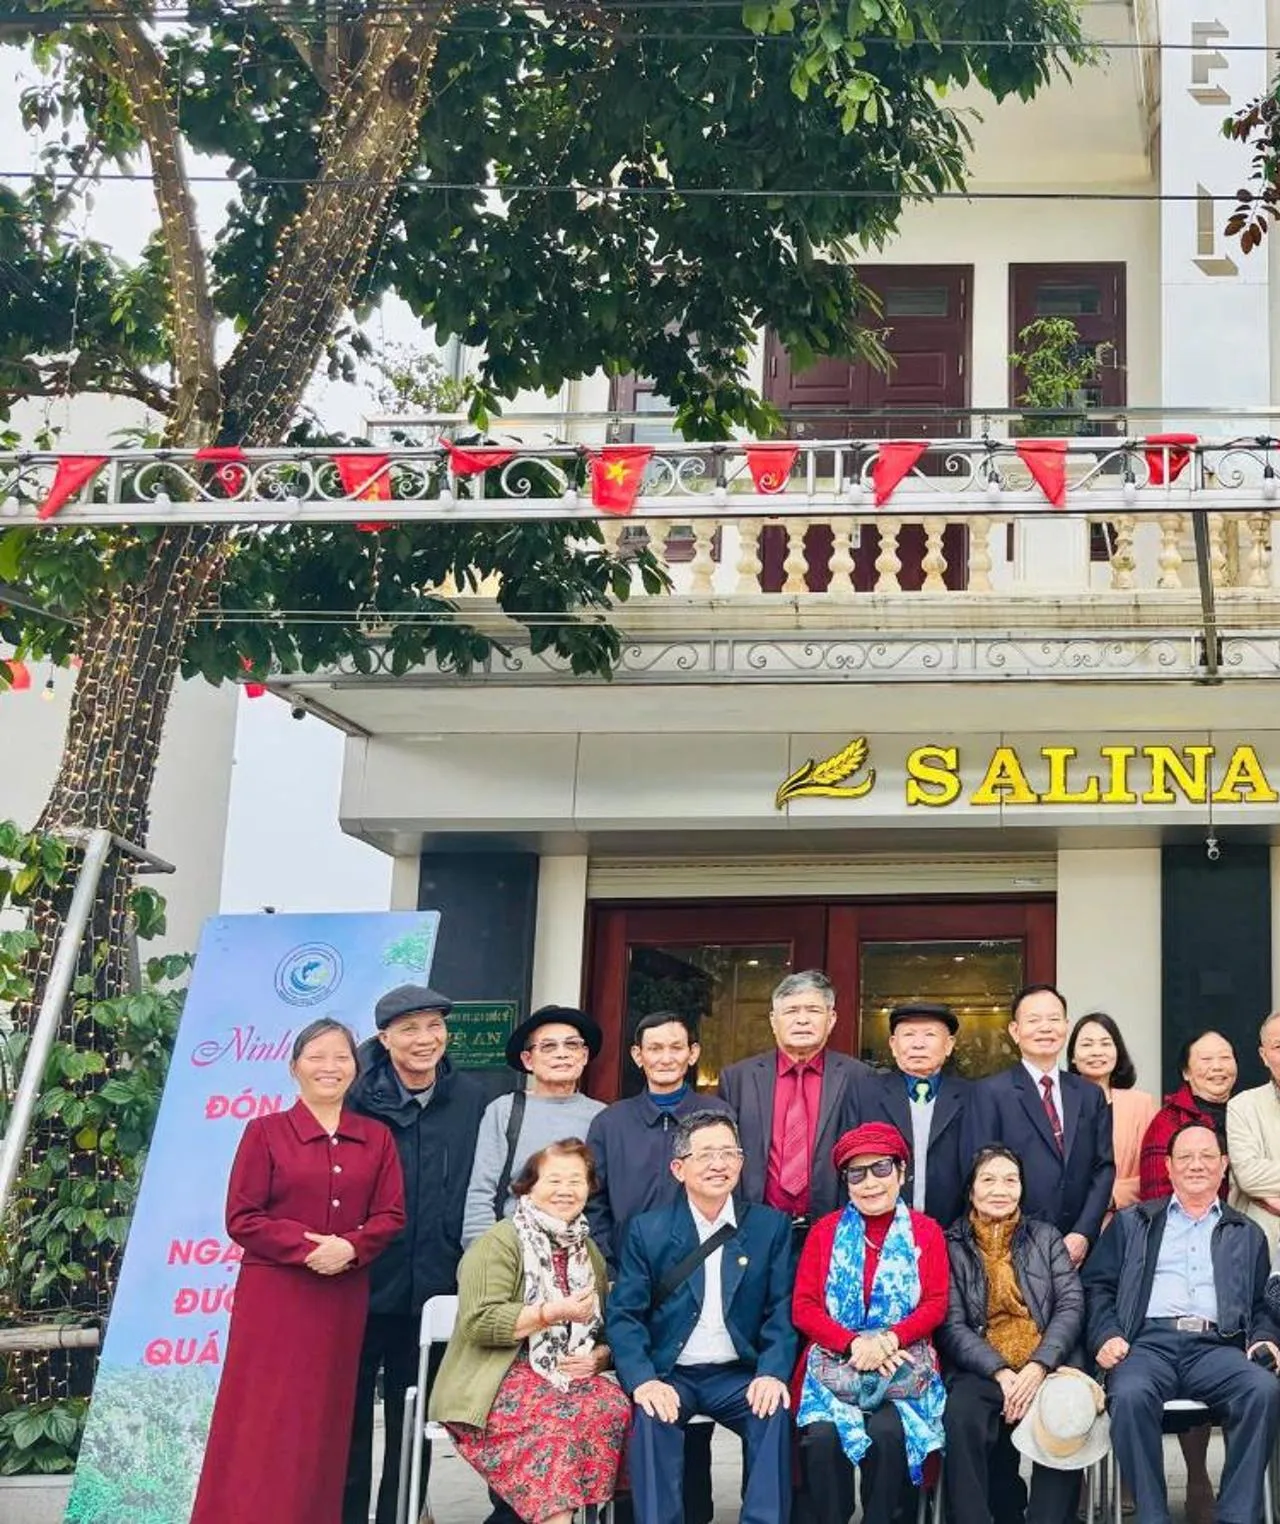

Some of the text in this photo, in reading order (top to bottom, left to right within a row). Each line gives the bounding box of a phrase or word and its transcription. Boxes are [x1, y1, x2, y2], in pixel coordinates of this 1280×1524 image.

[905, 744, 1279, 806] SALINA
[205, 1086, 283, 1120] ĐÓN
[145, 1329, 219, 1367] QUÁ
